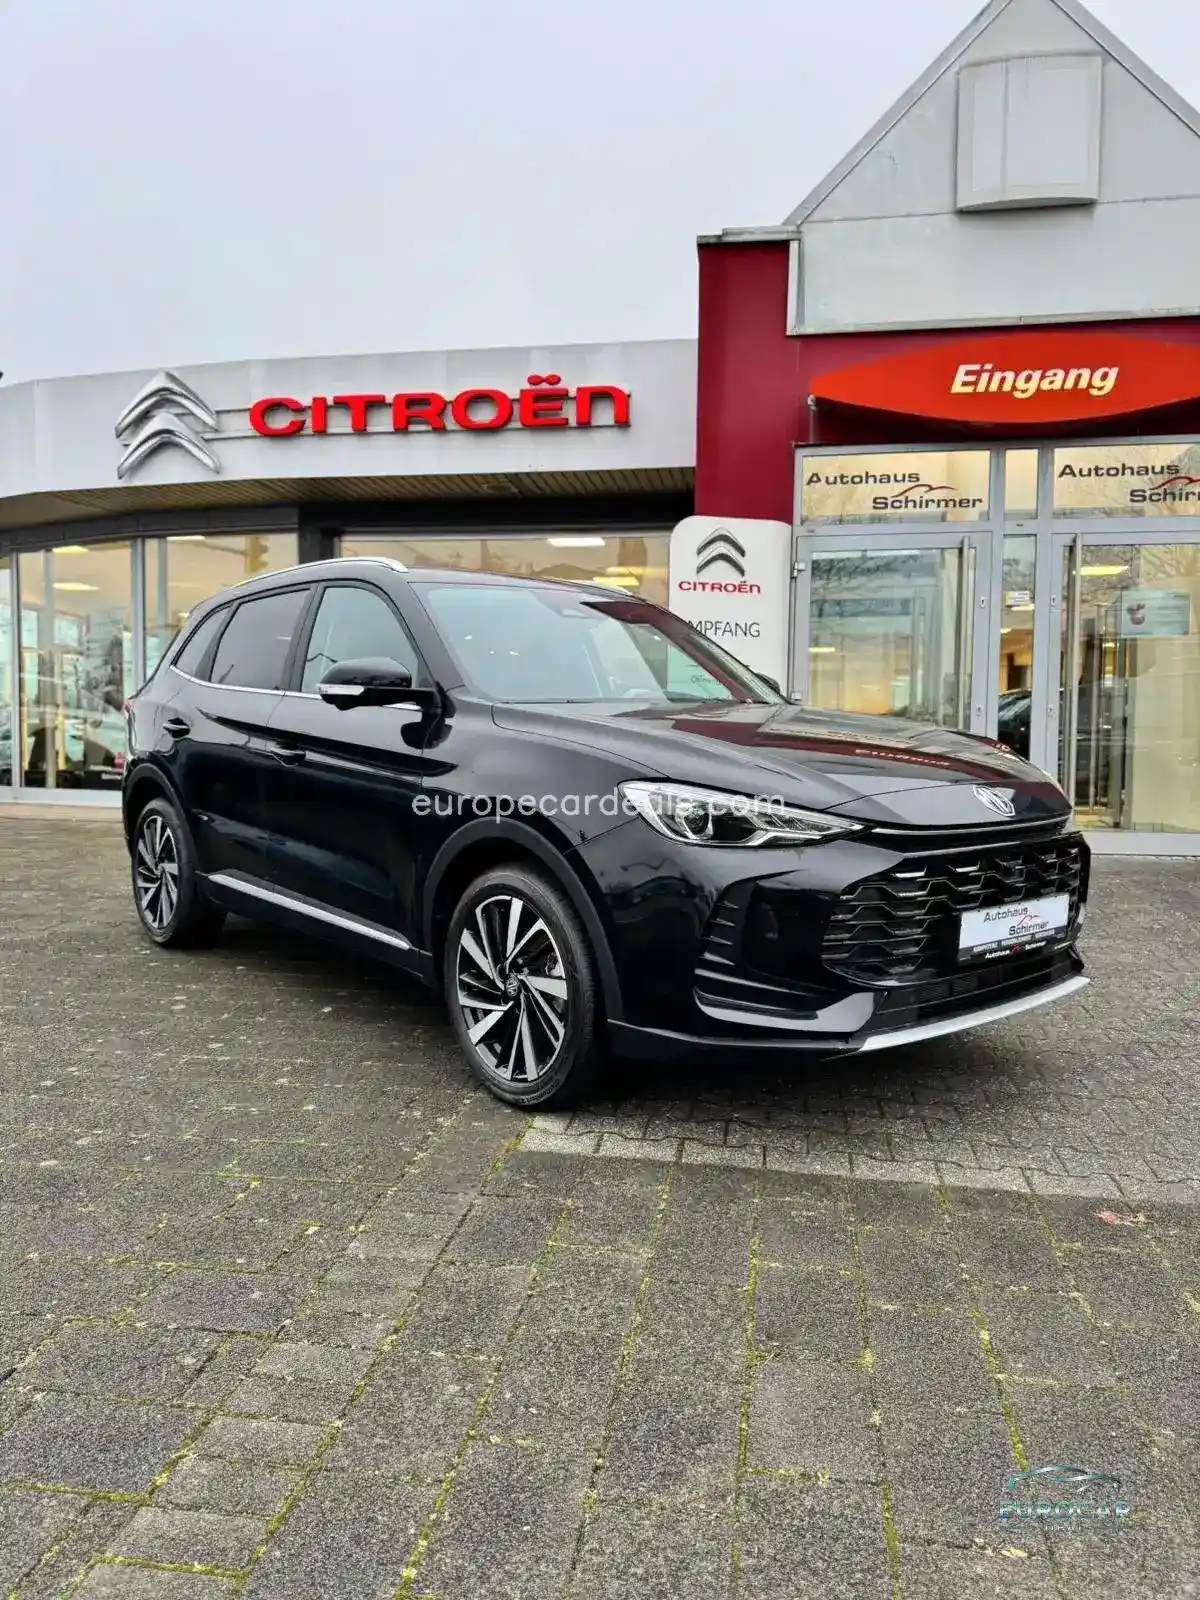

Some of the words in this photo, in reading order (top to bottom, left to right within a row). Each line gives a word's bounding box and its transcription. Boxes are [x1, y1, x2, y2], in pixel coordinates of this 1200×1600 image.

[951, 363, 1119, 399] Eingang
[1058, 463, 1180, 478] Autohaus
[806, 471, 920, 486] Autohaus
[872, 496, 983, 510] Schirmer
[1129, 488, 1200, 503] Schir
[687, 620, 761, 638] MPFANG
[983, 906, 1029, 922] Autohaus
[1008, 921, 1050, 937] Schirmer
